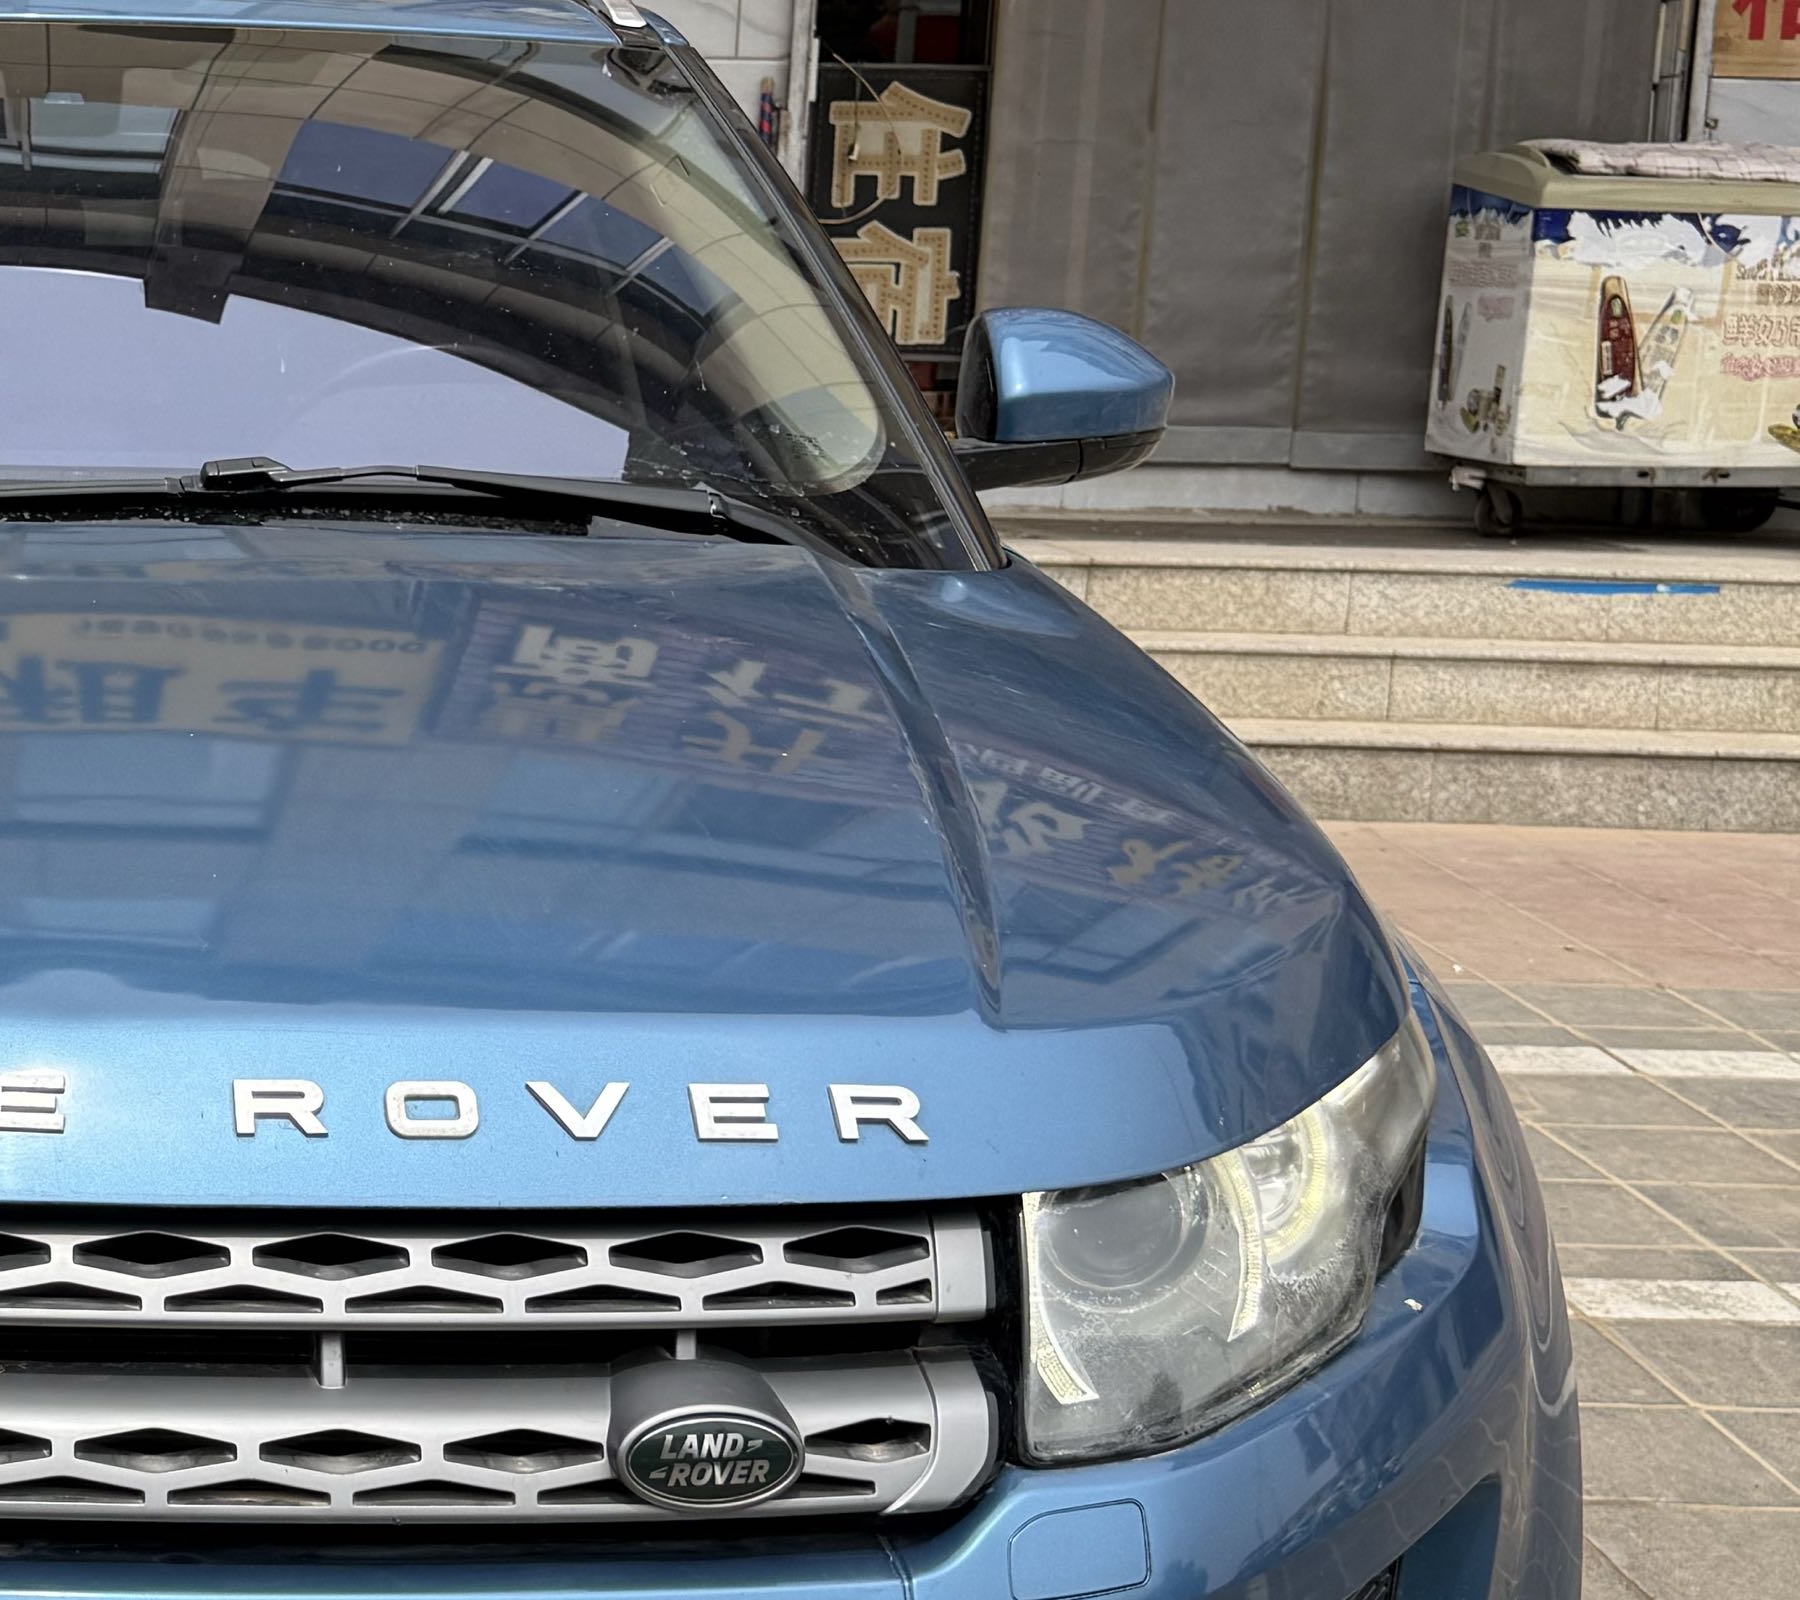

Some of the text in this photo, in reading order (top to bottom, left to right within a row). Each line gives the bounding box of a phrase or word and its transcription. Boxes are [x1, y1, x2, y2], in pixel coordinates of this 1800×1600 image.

[231, 1077, 930, 1144] ROVER
[660, 1433, 744, 1460] LAND
[667, 1460, 770, 1487] ROVER
